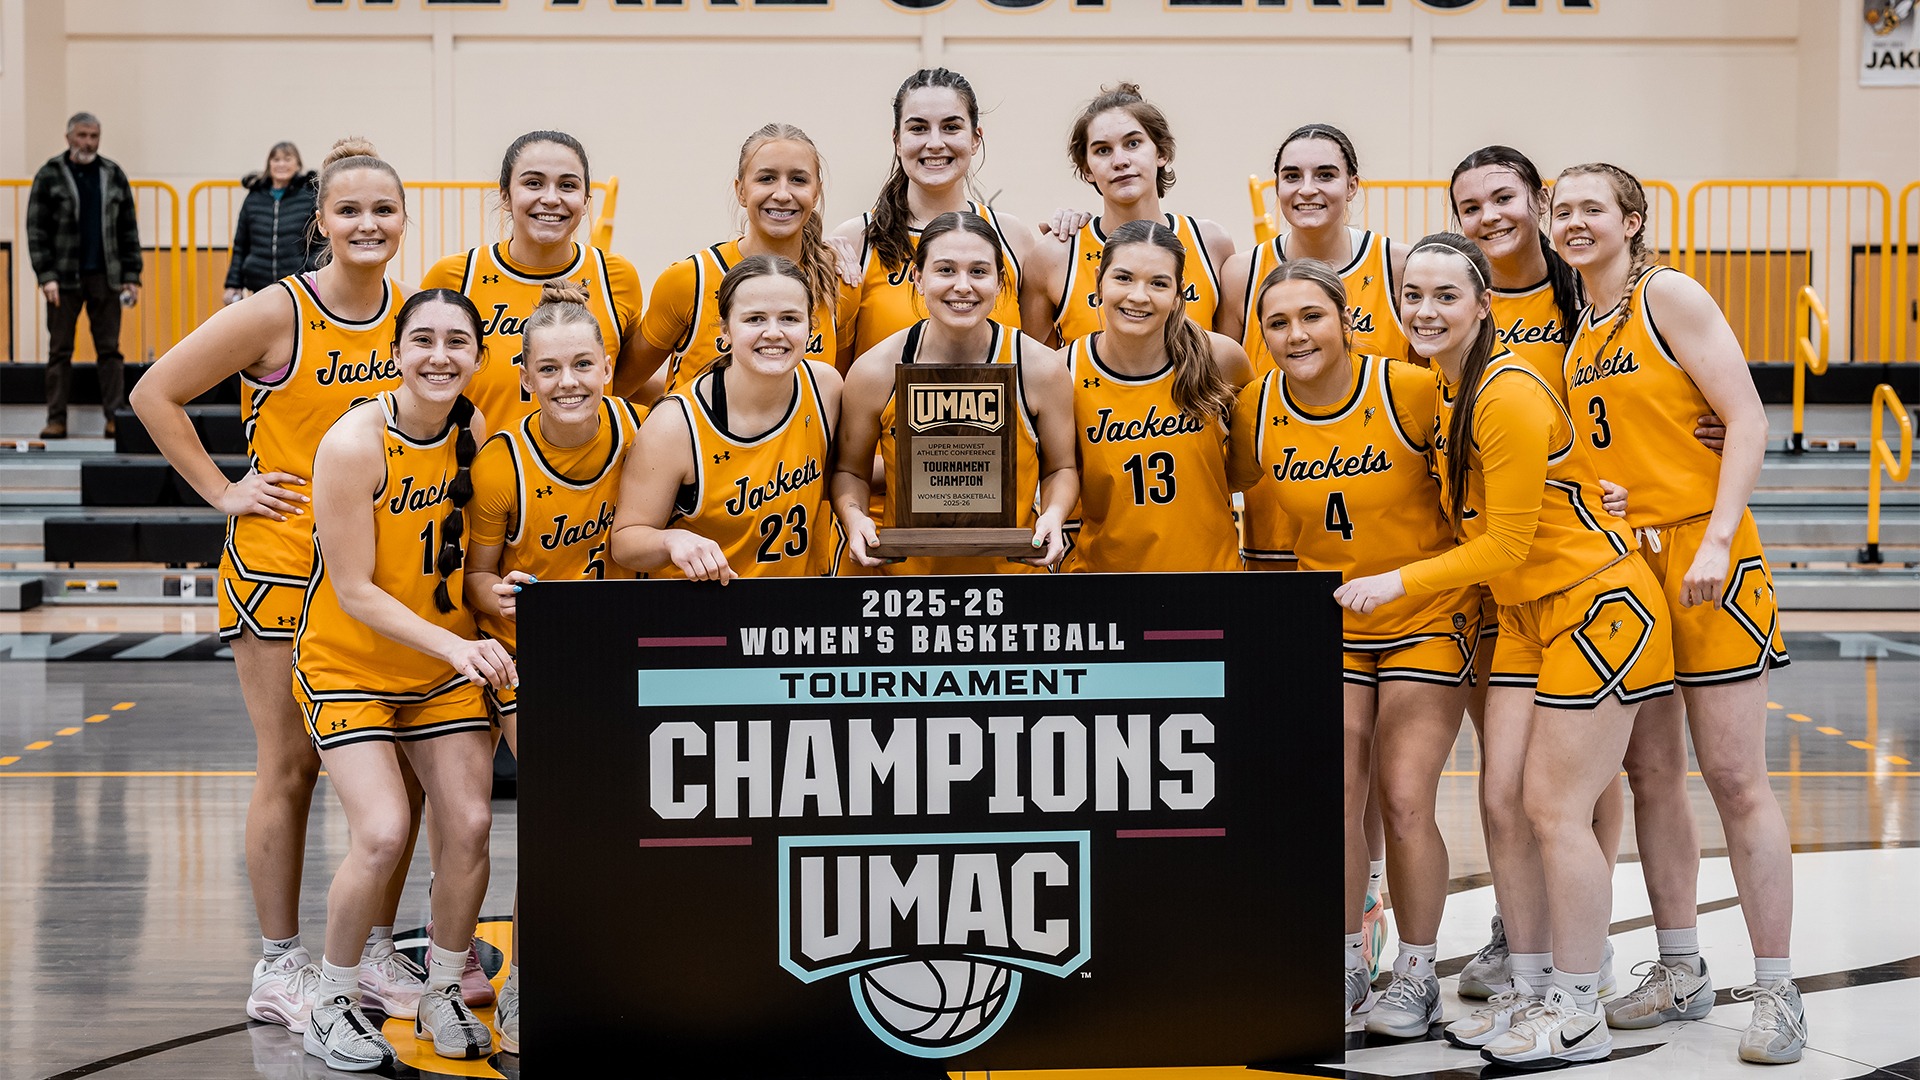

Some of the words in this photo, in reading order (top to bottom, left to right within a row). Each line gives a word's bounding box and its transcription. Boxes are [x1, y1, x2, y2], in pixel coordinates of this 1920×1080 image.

[1866, 51, 1920, 69] JAK
[917, 391, 995, 423] UMAC
[1588, 395, 1612, 449] 3
[923, 461, 990, 472] TOURNAMENT
[1122, 450, 1177, 506] 13
[1272, 443, 1393, 482] Jackets
[725, 454, 822, 517] Jackets
[930, 475, 983, 487] CHAMPION
[943, 499, 971, 507] 2025-26
[1324, 491, 1354, 541] 4
[756, 503, 809, 564] 23
[862, 588, 1004, 618] 2025-26
[740, 625, 895, 655] WOMEN'S
[911, 622, 1125, 653] BASKETBALL
[779, 668, 1088, 699] TOURNAMENT
[649, 713, 1216, 820] CHAMPIONS
[800, 852, 1070, 962] UMAC
[1080, 971, 1092, 979] TM
